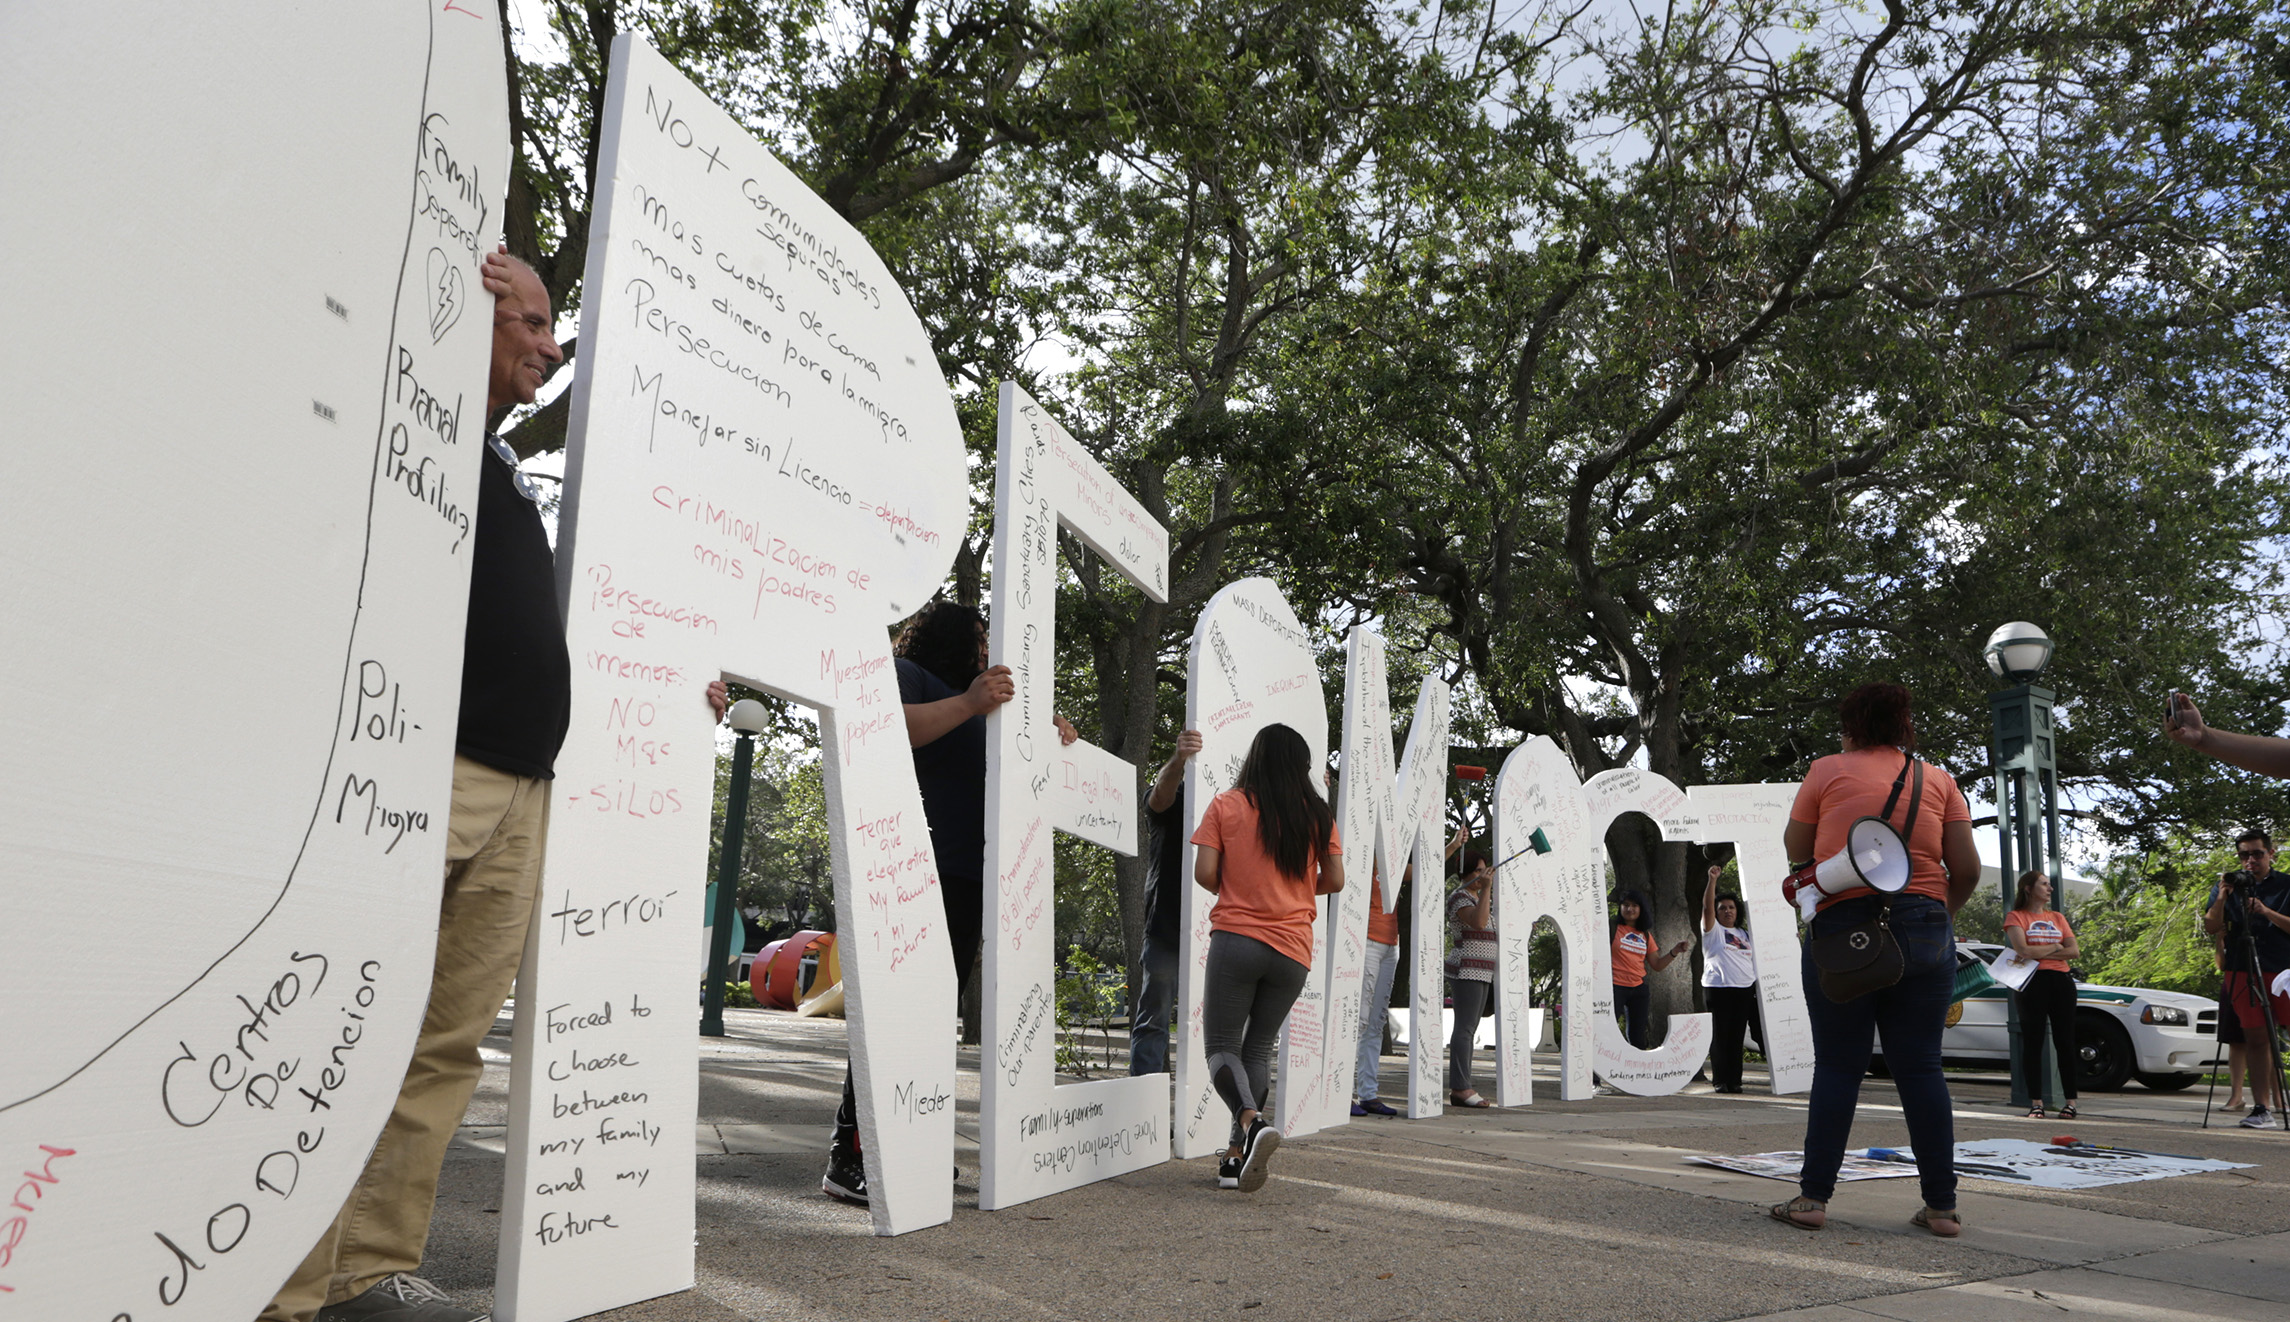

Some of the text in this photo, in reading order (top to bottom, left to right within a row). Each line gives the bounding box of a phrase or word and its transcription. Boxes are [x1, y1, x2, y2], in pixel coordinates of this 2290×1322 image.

[421, 113, 487, 234] Family
[625, 278, 792, 408] Persecucion
[711, 297, 772, 344] dinero
[396, 345, 462, 446] Racial
[631, 365, 738, 454] Manejar
[744, 437, 771, 462] sin
[1020, 404, 1045, 456] Raids
[1044, 422, 1102, 492] Persecution
[587, 563, 718, 636] Persecucion
[694, 543, 837, 621] mis padres
[847, 567, 871, 592] de
[1233, 593, 1256, 618] MASS
[611, 616, 645, 639] de
[856, 683, 882, 709] tus
[1016, 623, 1038, 763] Criminalizing
[880, 833, 902, 861] que
[161, 950, 329, 1128] Centros
[545, 993, 651, 1043] Forced to
[244, 1056, 302, 1109] De
[256, 959, 381, 1200] Detencion
[552, 1089, 649, 1119] between
[893, 1079, 951, 1124] Miedo
[1187, 1079, 1214, 1140] E-VERI
[539, 1116, 661, 1157] my family
[536, 1167, 650, 1196] and my
[535, 1211, 619, 1247] future
